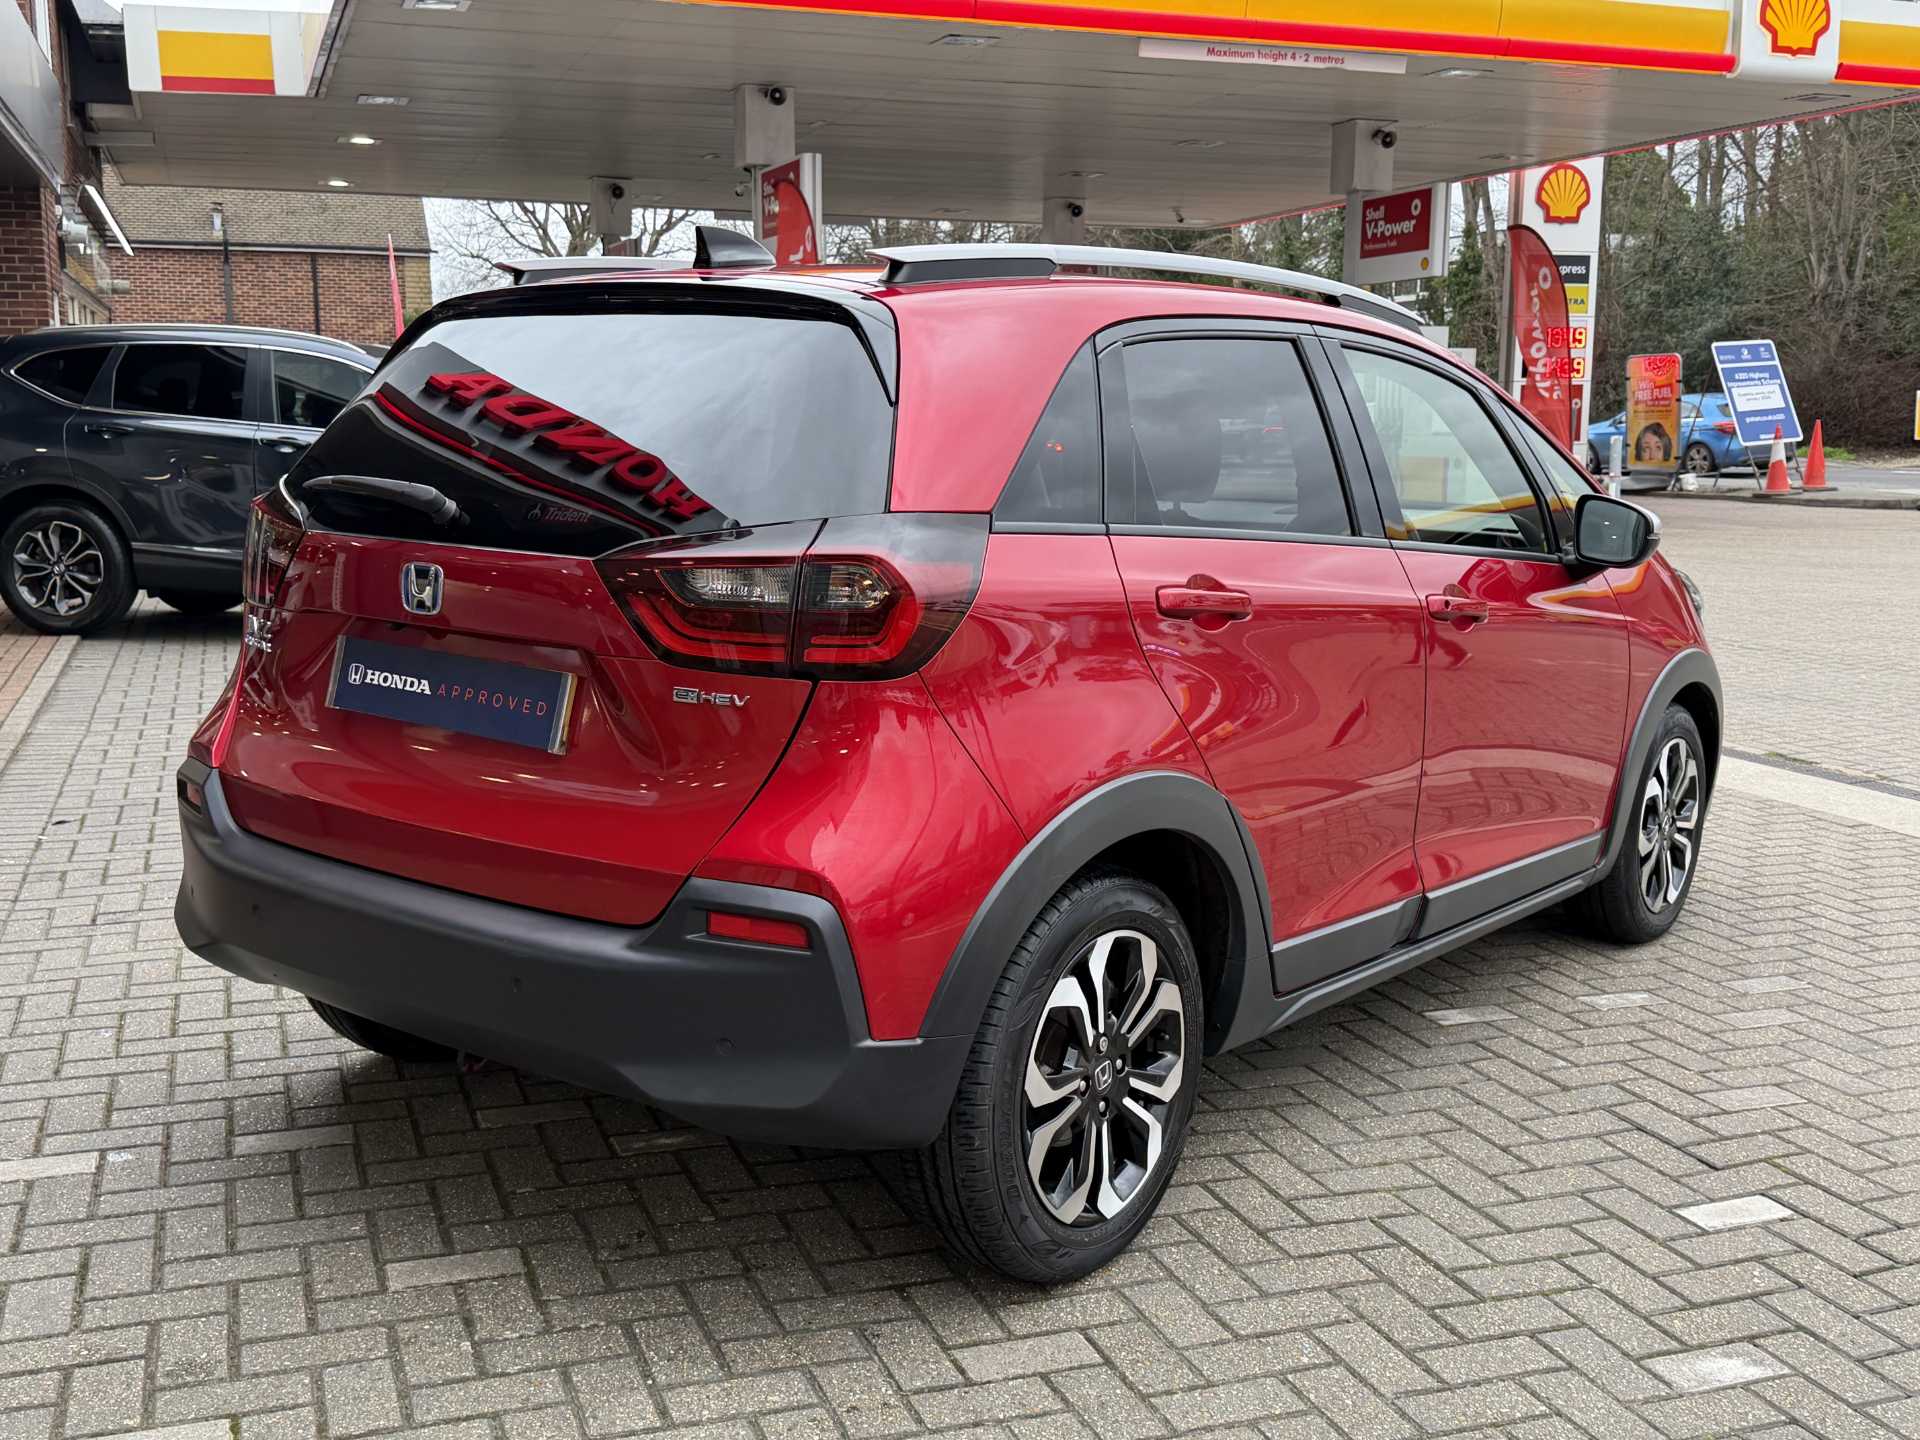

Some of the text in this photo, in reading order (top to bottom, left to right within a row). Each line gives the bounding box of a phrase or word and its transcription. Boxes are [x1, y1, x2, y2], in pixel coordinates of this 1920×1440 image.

[1206, 46, 1255, 59] Maximum
[1257, 49, 1288, 63] height
[1313, 55, 1345, 65] metres
[1366, 204, 1385, 221] Shell
[1365, 219, 1417, 240] V-Power
[1559, 264, 1587, 276] xpress
[1567, 297, 1586, 306] TRA
[545, 506, 592, 523] Trident
[364, 668, 549, 717] HONDA APPROVED
